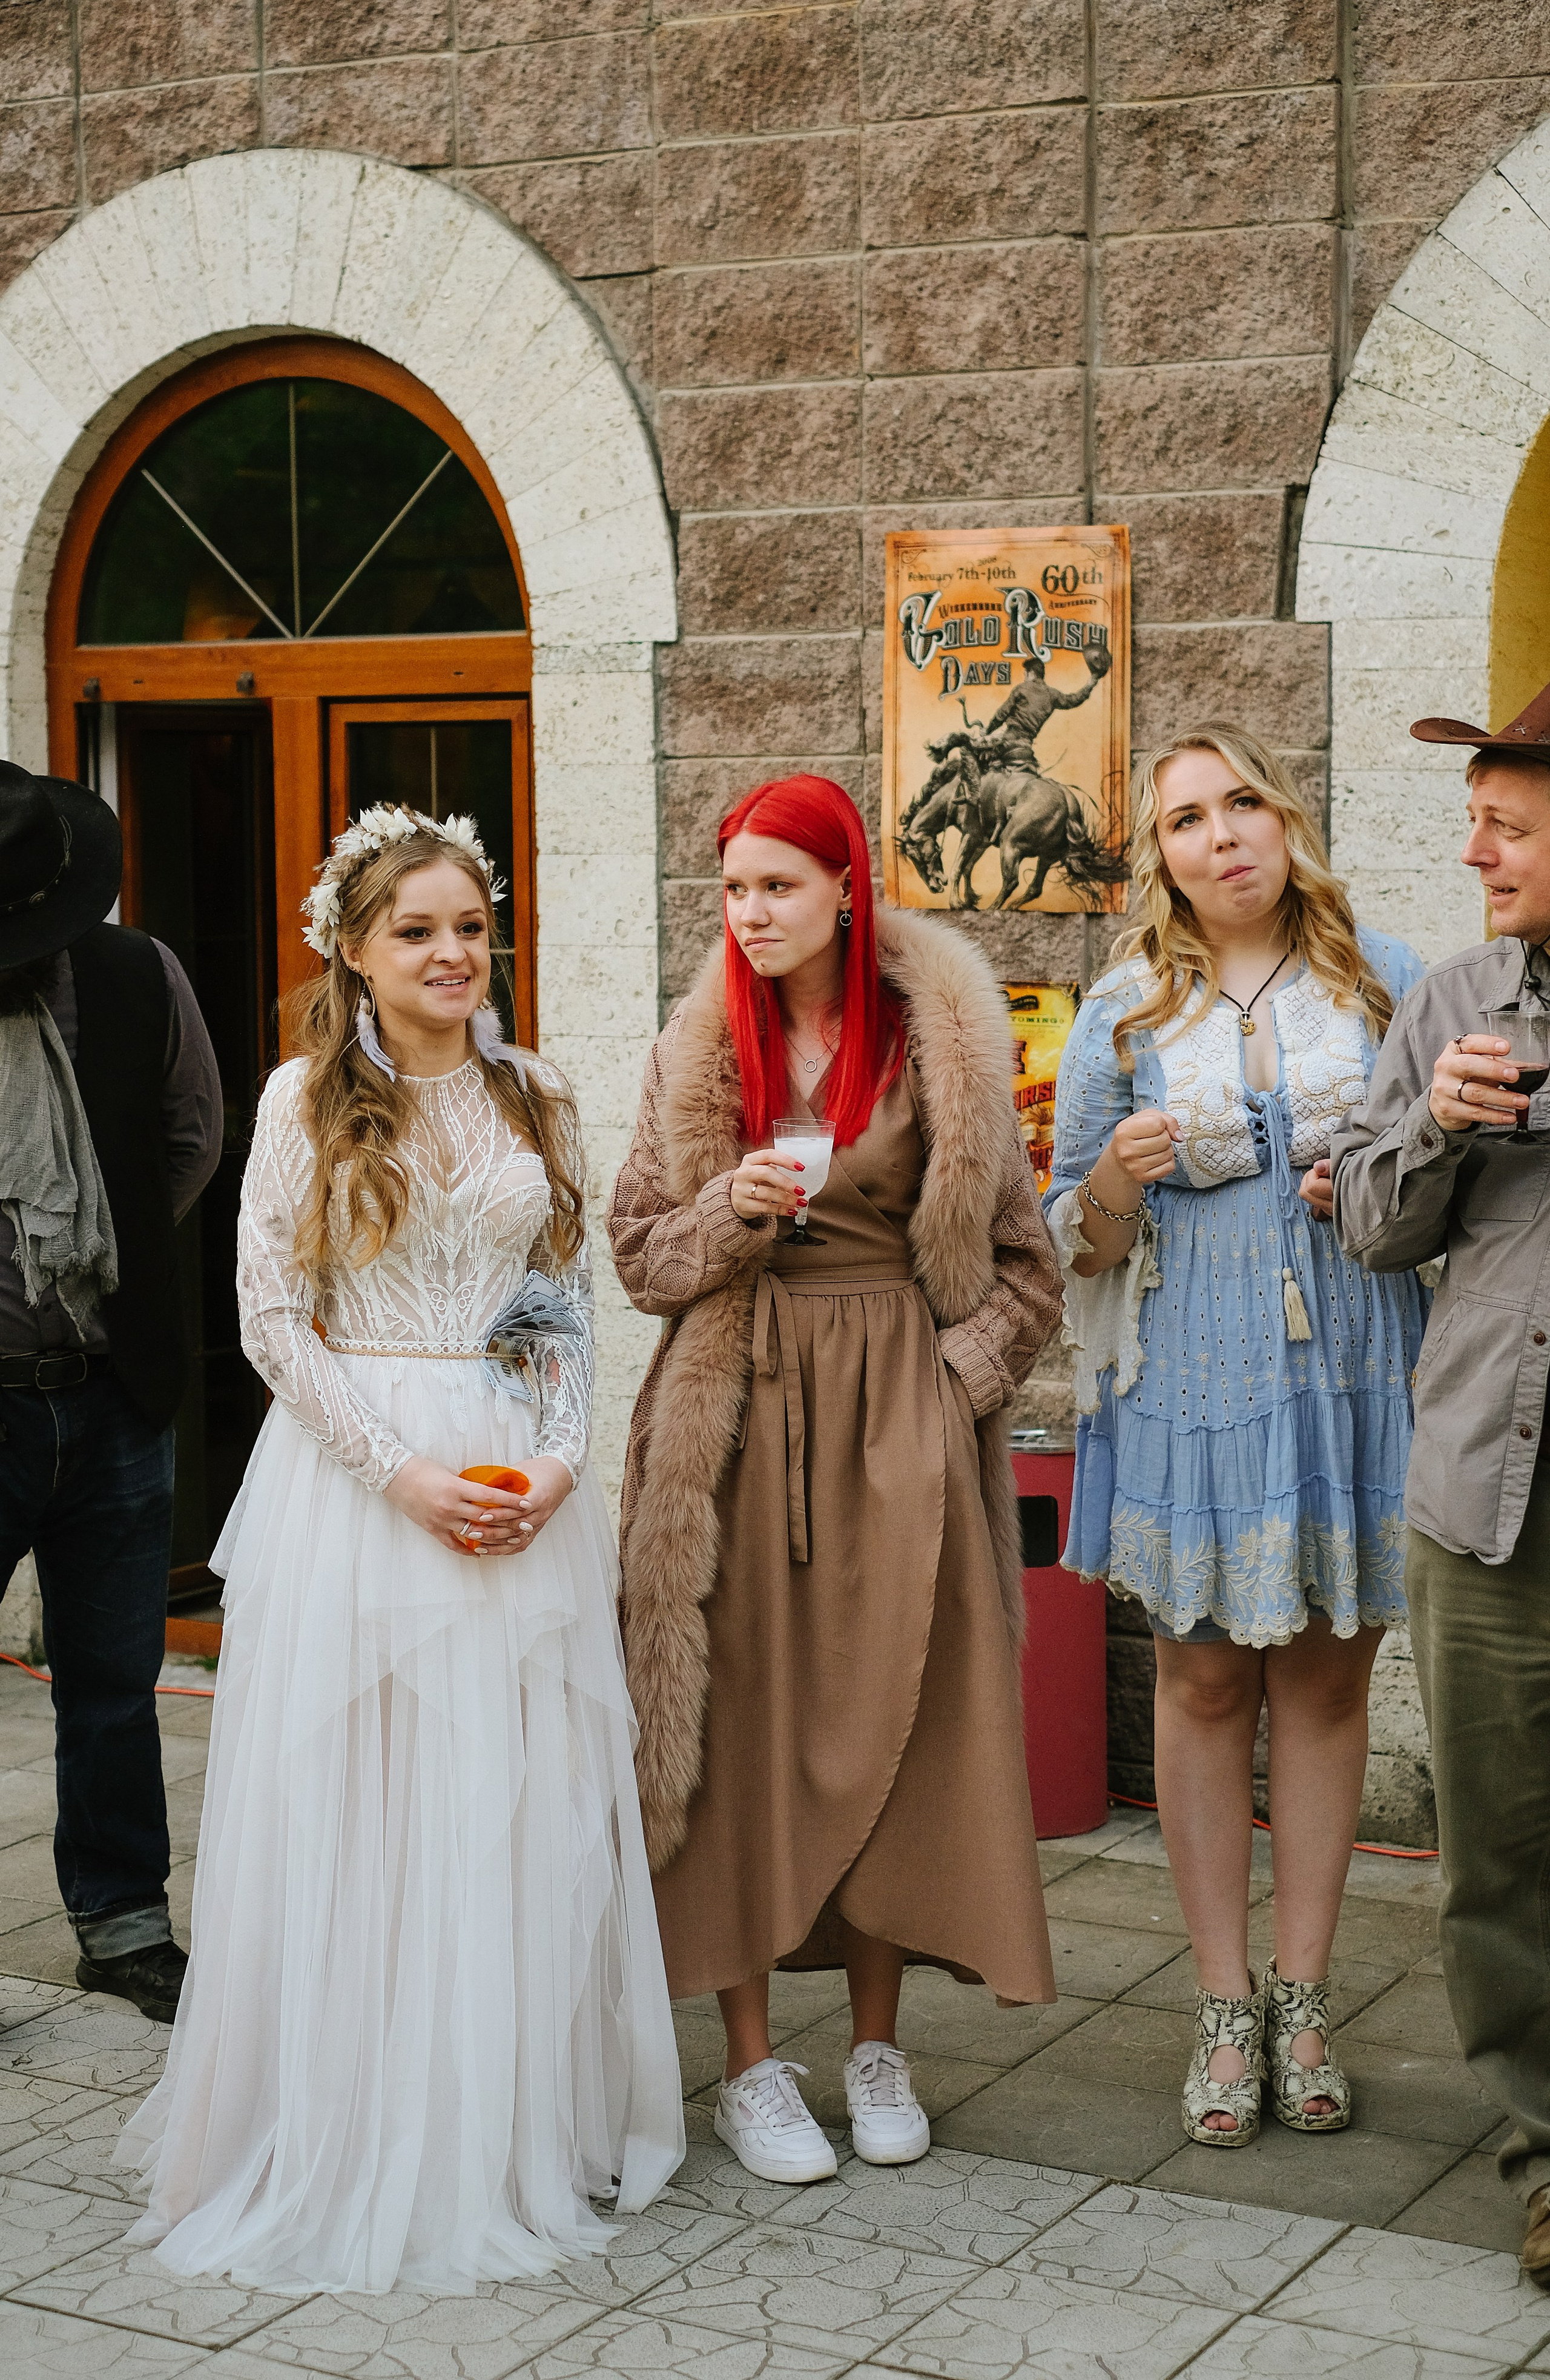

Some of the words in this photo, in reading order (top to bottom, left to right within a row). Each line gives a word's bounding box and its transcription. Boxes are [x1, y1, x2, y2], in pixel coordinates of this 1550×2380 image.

[1041, 564, 1103, 593] 60th
[899, 590, 1000, 671] GOLD
[995, 587, 1109, 663] RUSH
[937, 655, 1011, 701] DAYS
